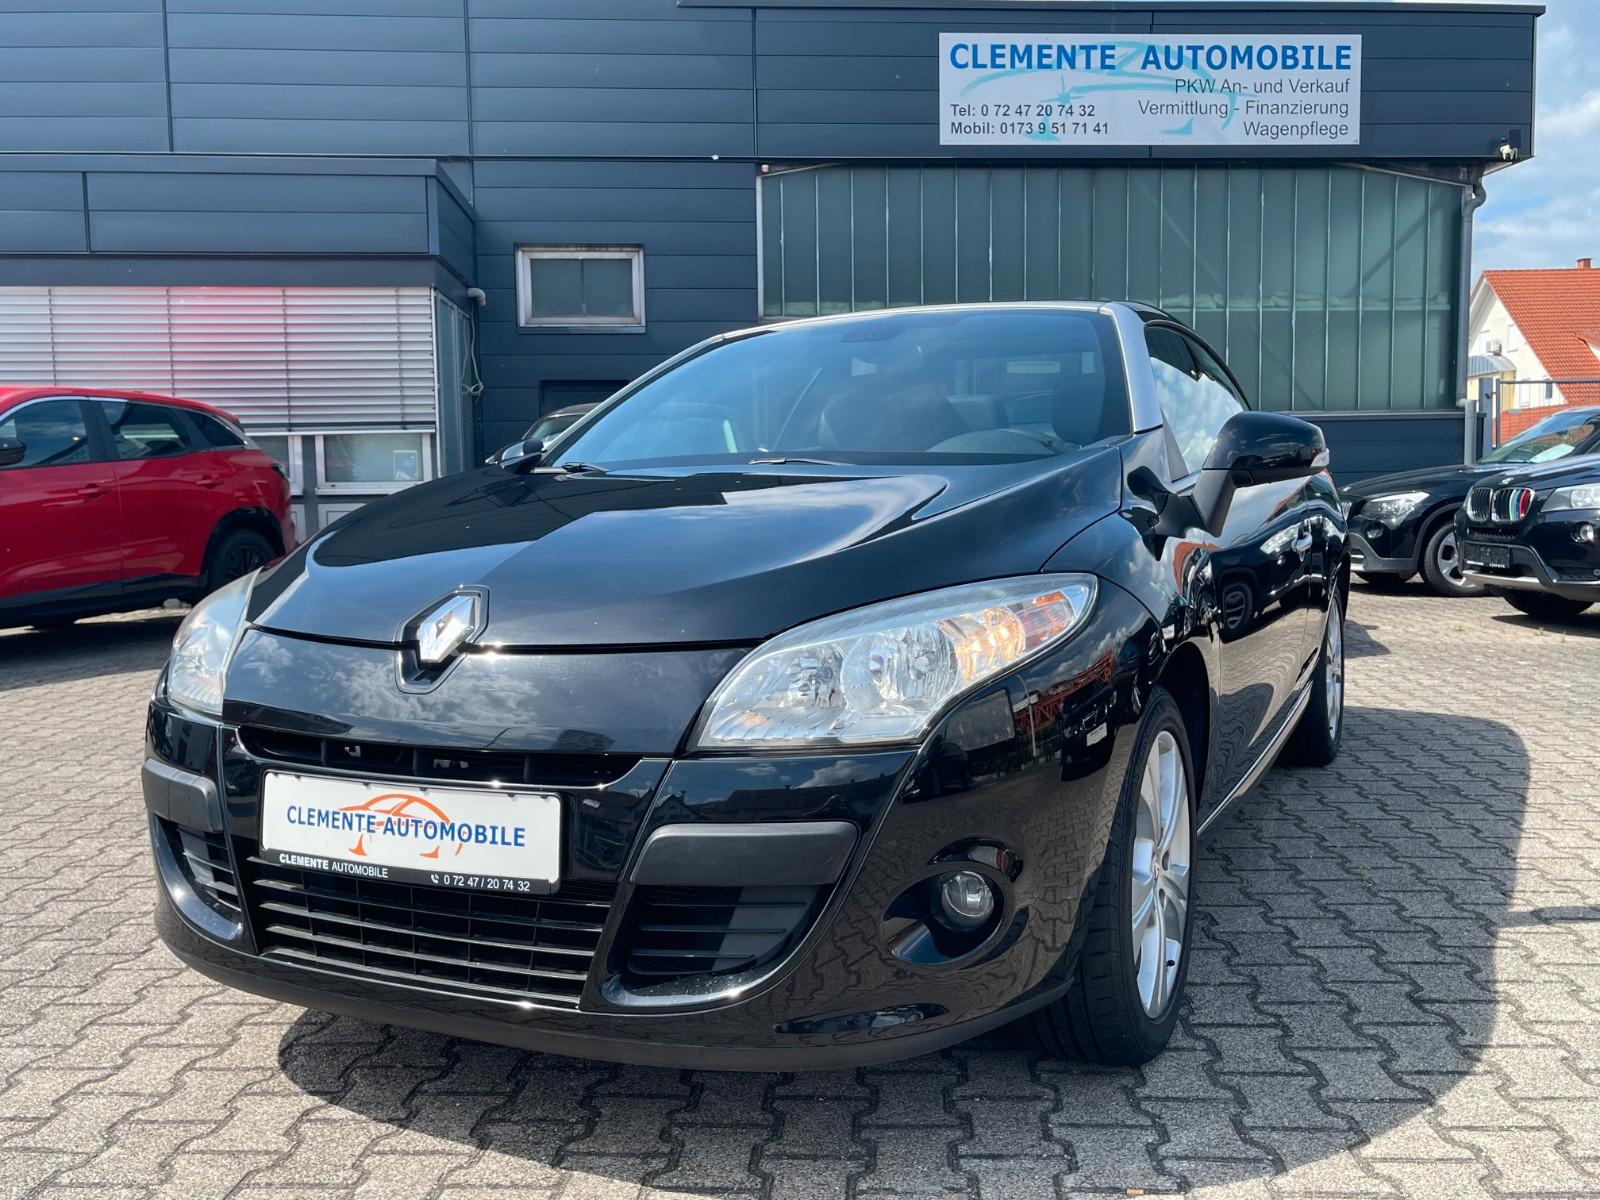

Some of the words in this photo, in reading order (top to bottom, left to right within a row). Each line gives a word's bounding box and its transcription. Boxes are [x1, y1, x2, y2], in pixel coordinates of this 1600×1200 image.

[950, 43, 1116, 70] CLEMENTE
[1141, 44, 1352, 70] AUTOMOBILE
[1175, 79, 1216, 93] PKW
[1219, 79, 1248, 93] An-
[1254, 78, 1283, 93] und
[1288, 78, 1351, 94] Verkauf
[950, 104, 976, 117] Tel:
[981, 104, 989, 117] 0
[994, 104, 1011, 117] 72
[1015, 104, 1031, 117] 47
[1036, 104, 1053, 117] 20
[1057, 104, 1074, 117] 74
[1079, 104, 1096, 117] 32
[1138, 100, 1229, 118] Vermittlung
[1245, 100, 1349, 118] Finanzierung
[950, 122, 995, 135] Mobil:
[1000, 122, 1034, 135] 0173
[1038, 122, 1046, 135] 9
[1051, 122, 1068, 135] 51
[1072, 122, 1088, 135] 71
[1093, 122, 1108, 135] 41
[1243, 121, 1349, 139] Wagenpflege
[286, 805, 377, 833] CLEMENTE
[383, 816, 526, 847] AUTOMOBILE
[279, 853, 329, 870] CLEMENTE
[331, 861, 389, 878] AUTOMOBILE
[453, 875, 465, 886] 72
[467, 876, 479, 888] 47
[487, 878, 500, 889] 20
[502, 879, 514, 890] 74
[517, 880, 530, 892] 32
